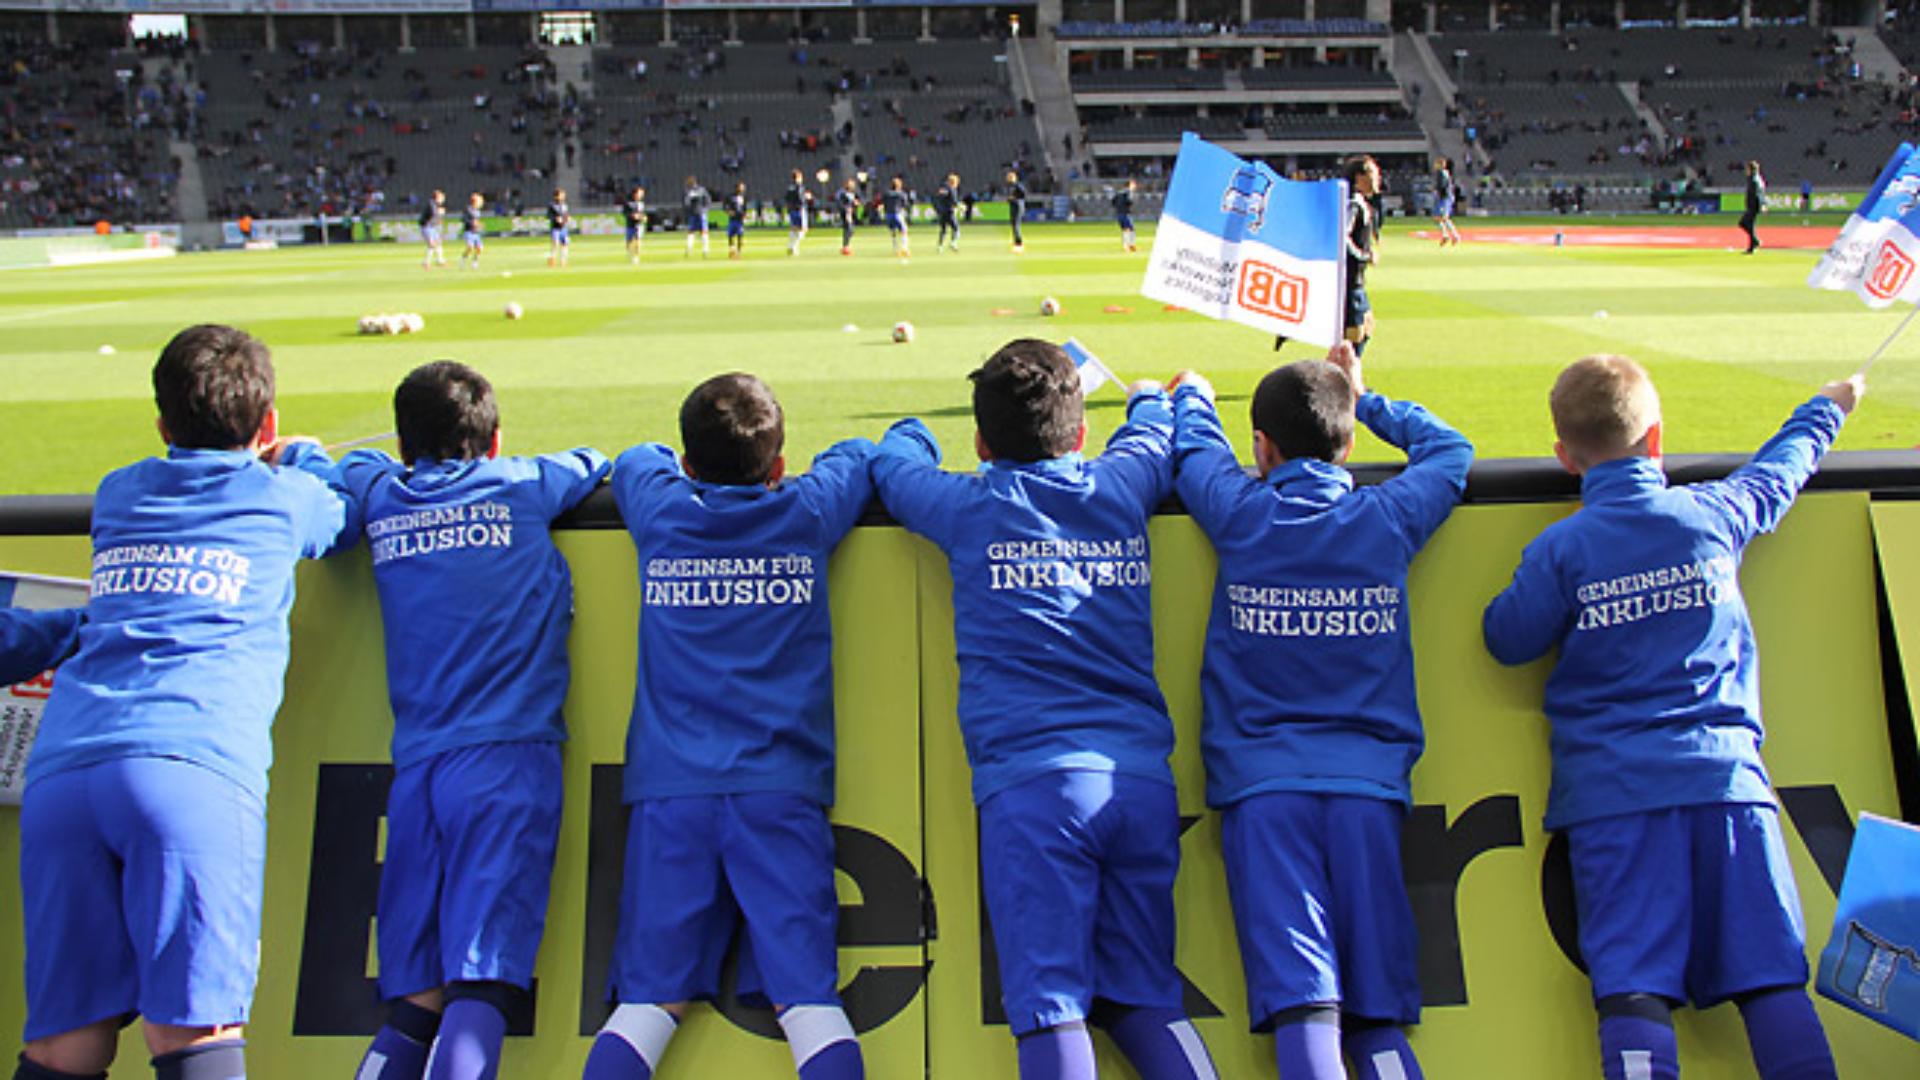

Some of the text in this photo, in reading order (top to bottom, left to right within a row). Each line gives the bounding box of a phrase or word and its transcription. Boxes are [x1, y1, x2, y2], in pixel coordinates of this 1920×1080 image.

[470, 500, 511, 522] FÜR
[1126, 535, 1146, 557] FÜ
[200, 549, 250, 577] FÜR
[772, 553, 814, 575] FÜR
[646, 579, 814, 607] INKLUSION
[1362, 584, 1399, 607] FÜR
[1230, 605, 1397, 636] INKLUSION
